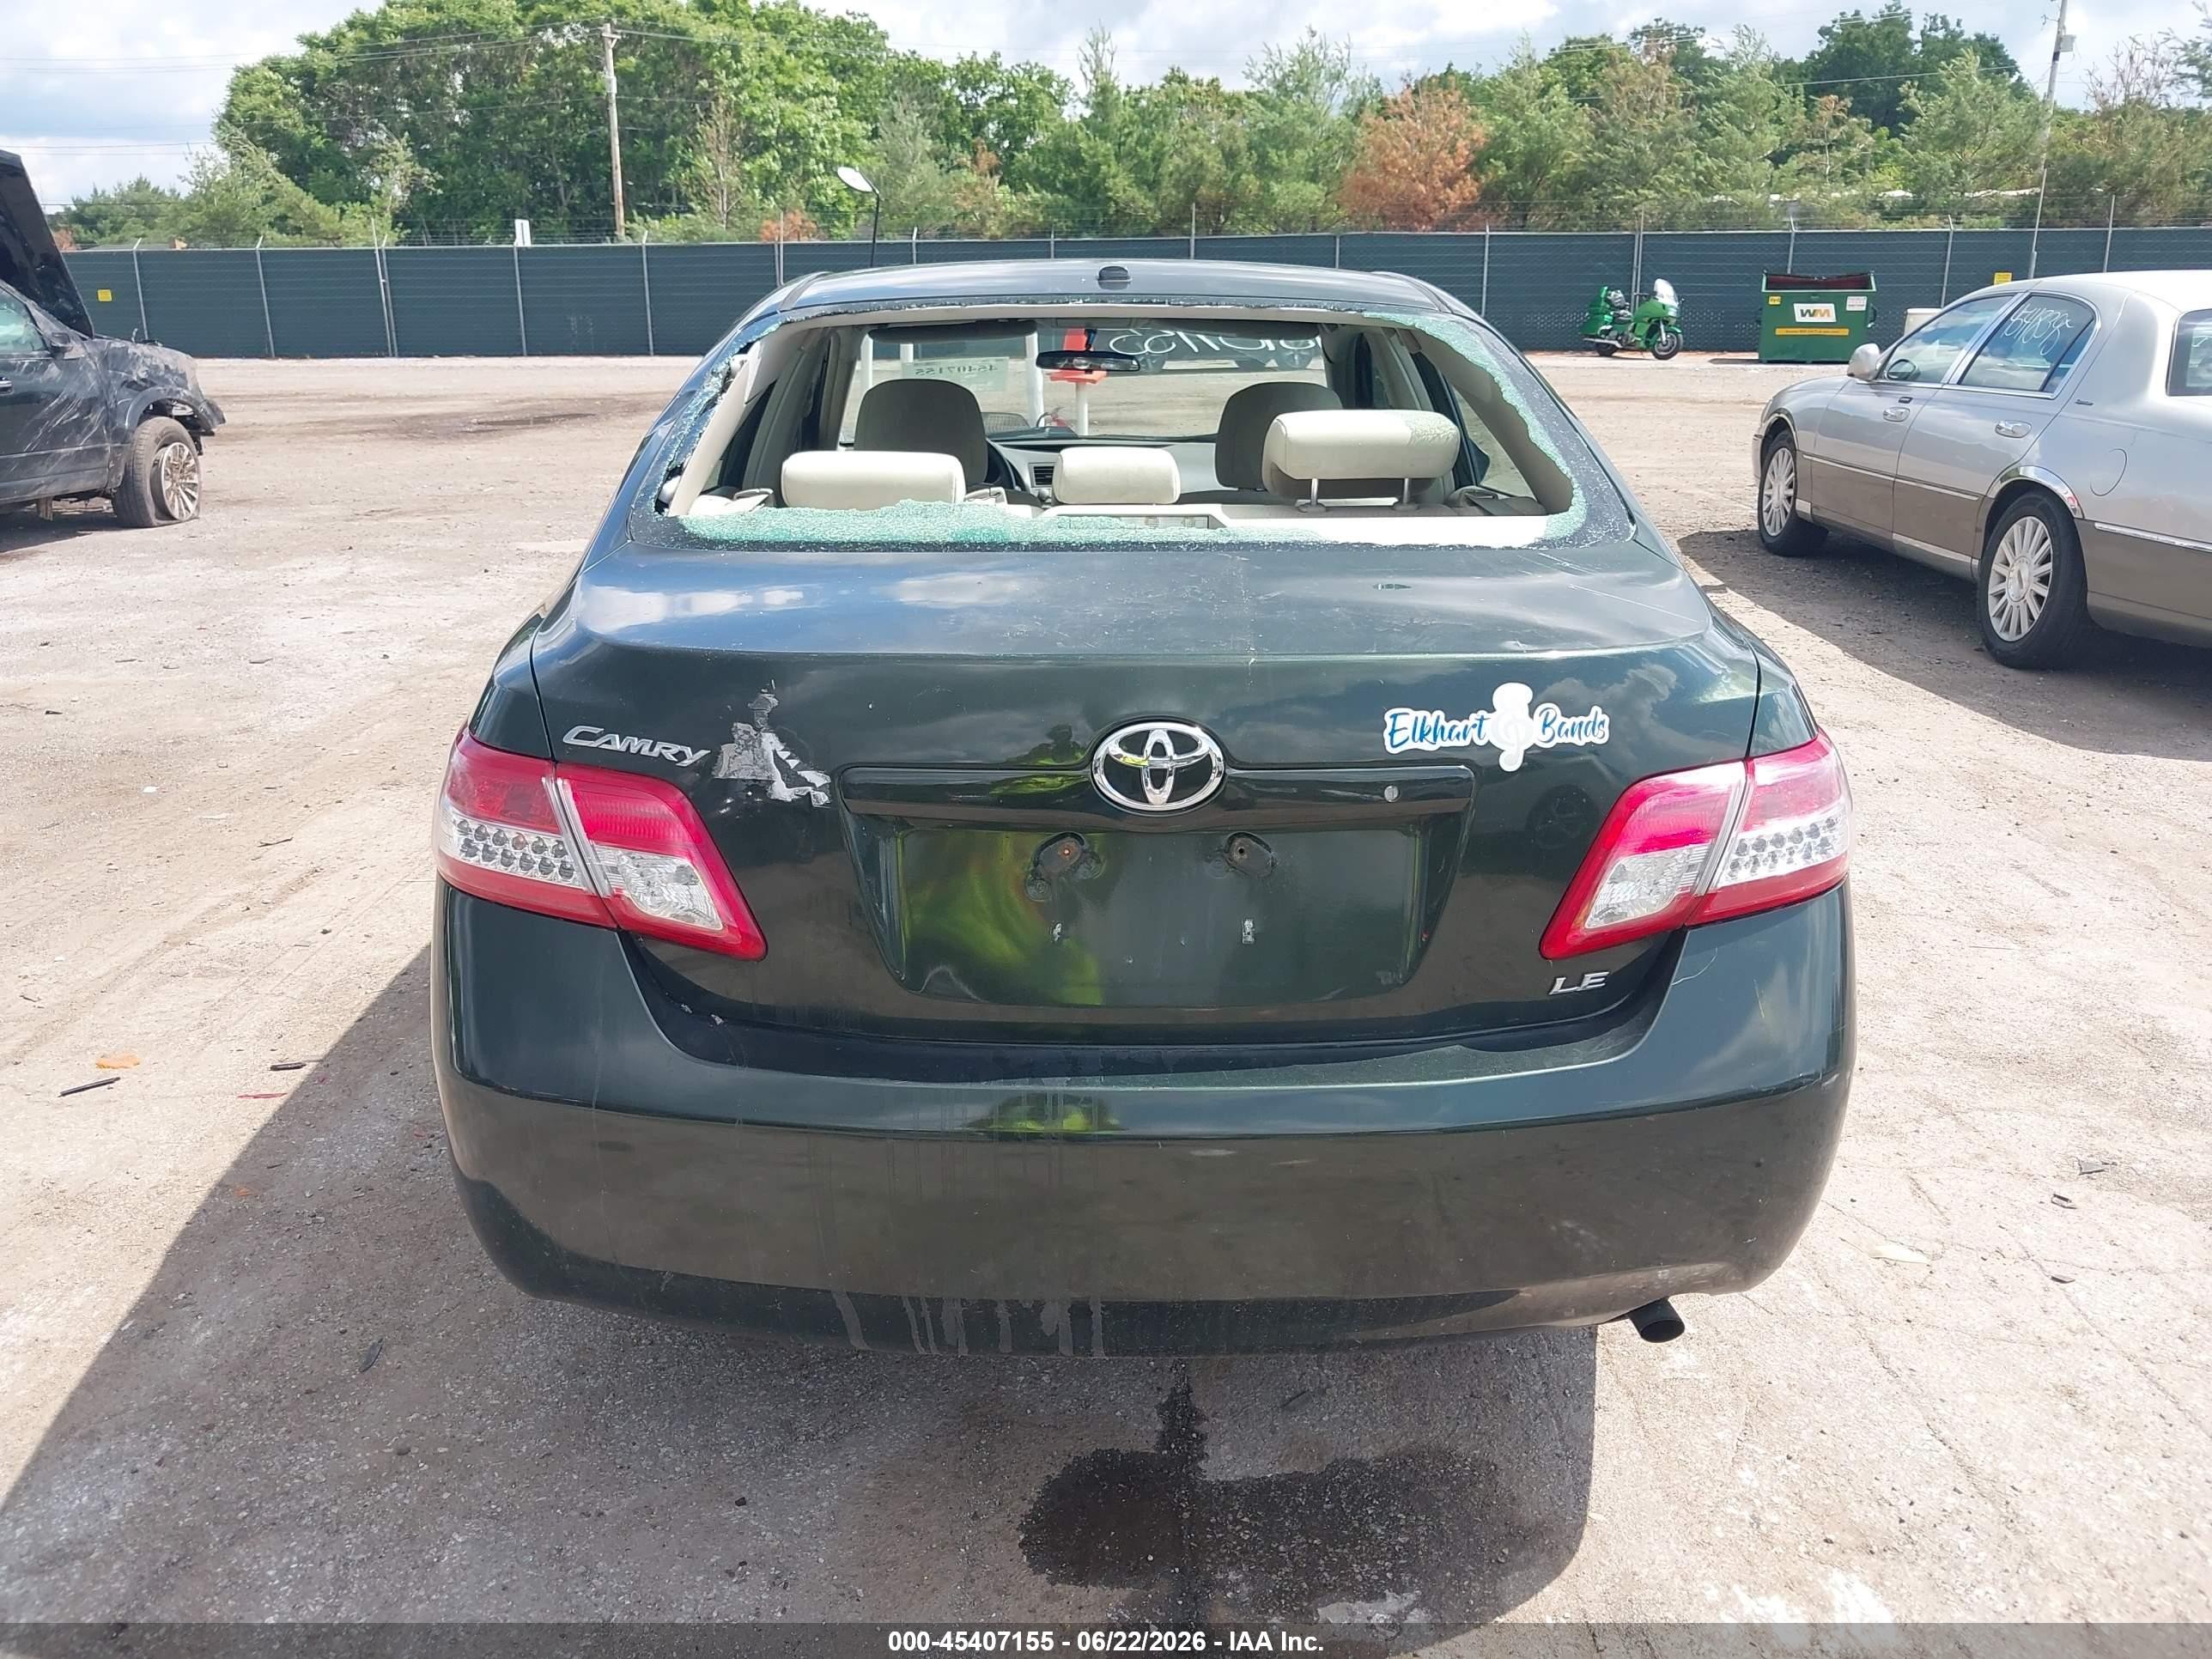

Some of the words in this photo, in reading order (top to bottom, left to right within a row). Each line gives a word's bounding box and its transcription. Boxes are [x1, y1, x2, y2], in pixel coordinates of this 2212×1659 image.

[1800, 308, 1831, 318] WM
[1388, 711, 1492, 749] Elkhart
[1538, 707, 1606, 744] Bands
[562, 725, 711, 767] CAMRY
[1548, 971, 1610, 995] LE
